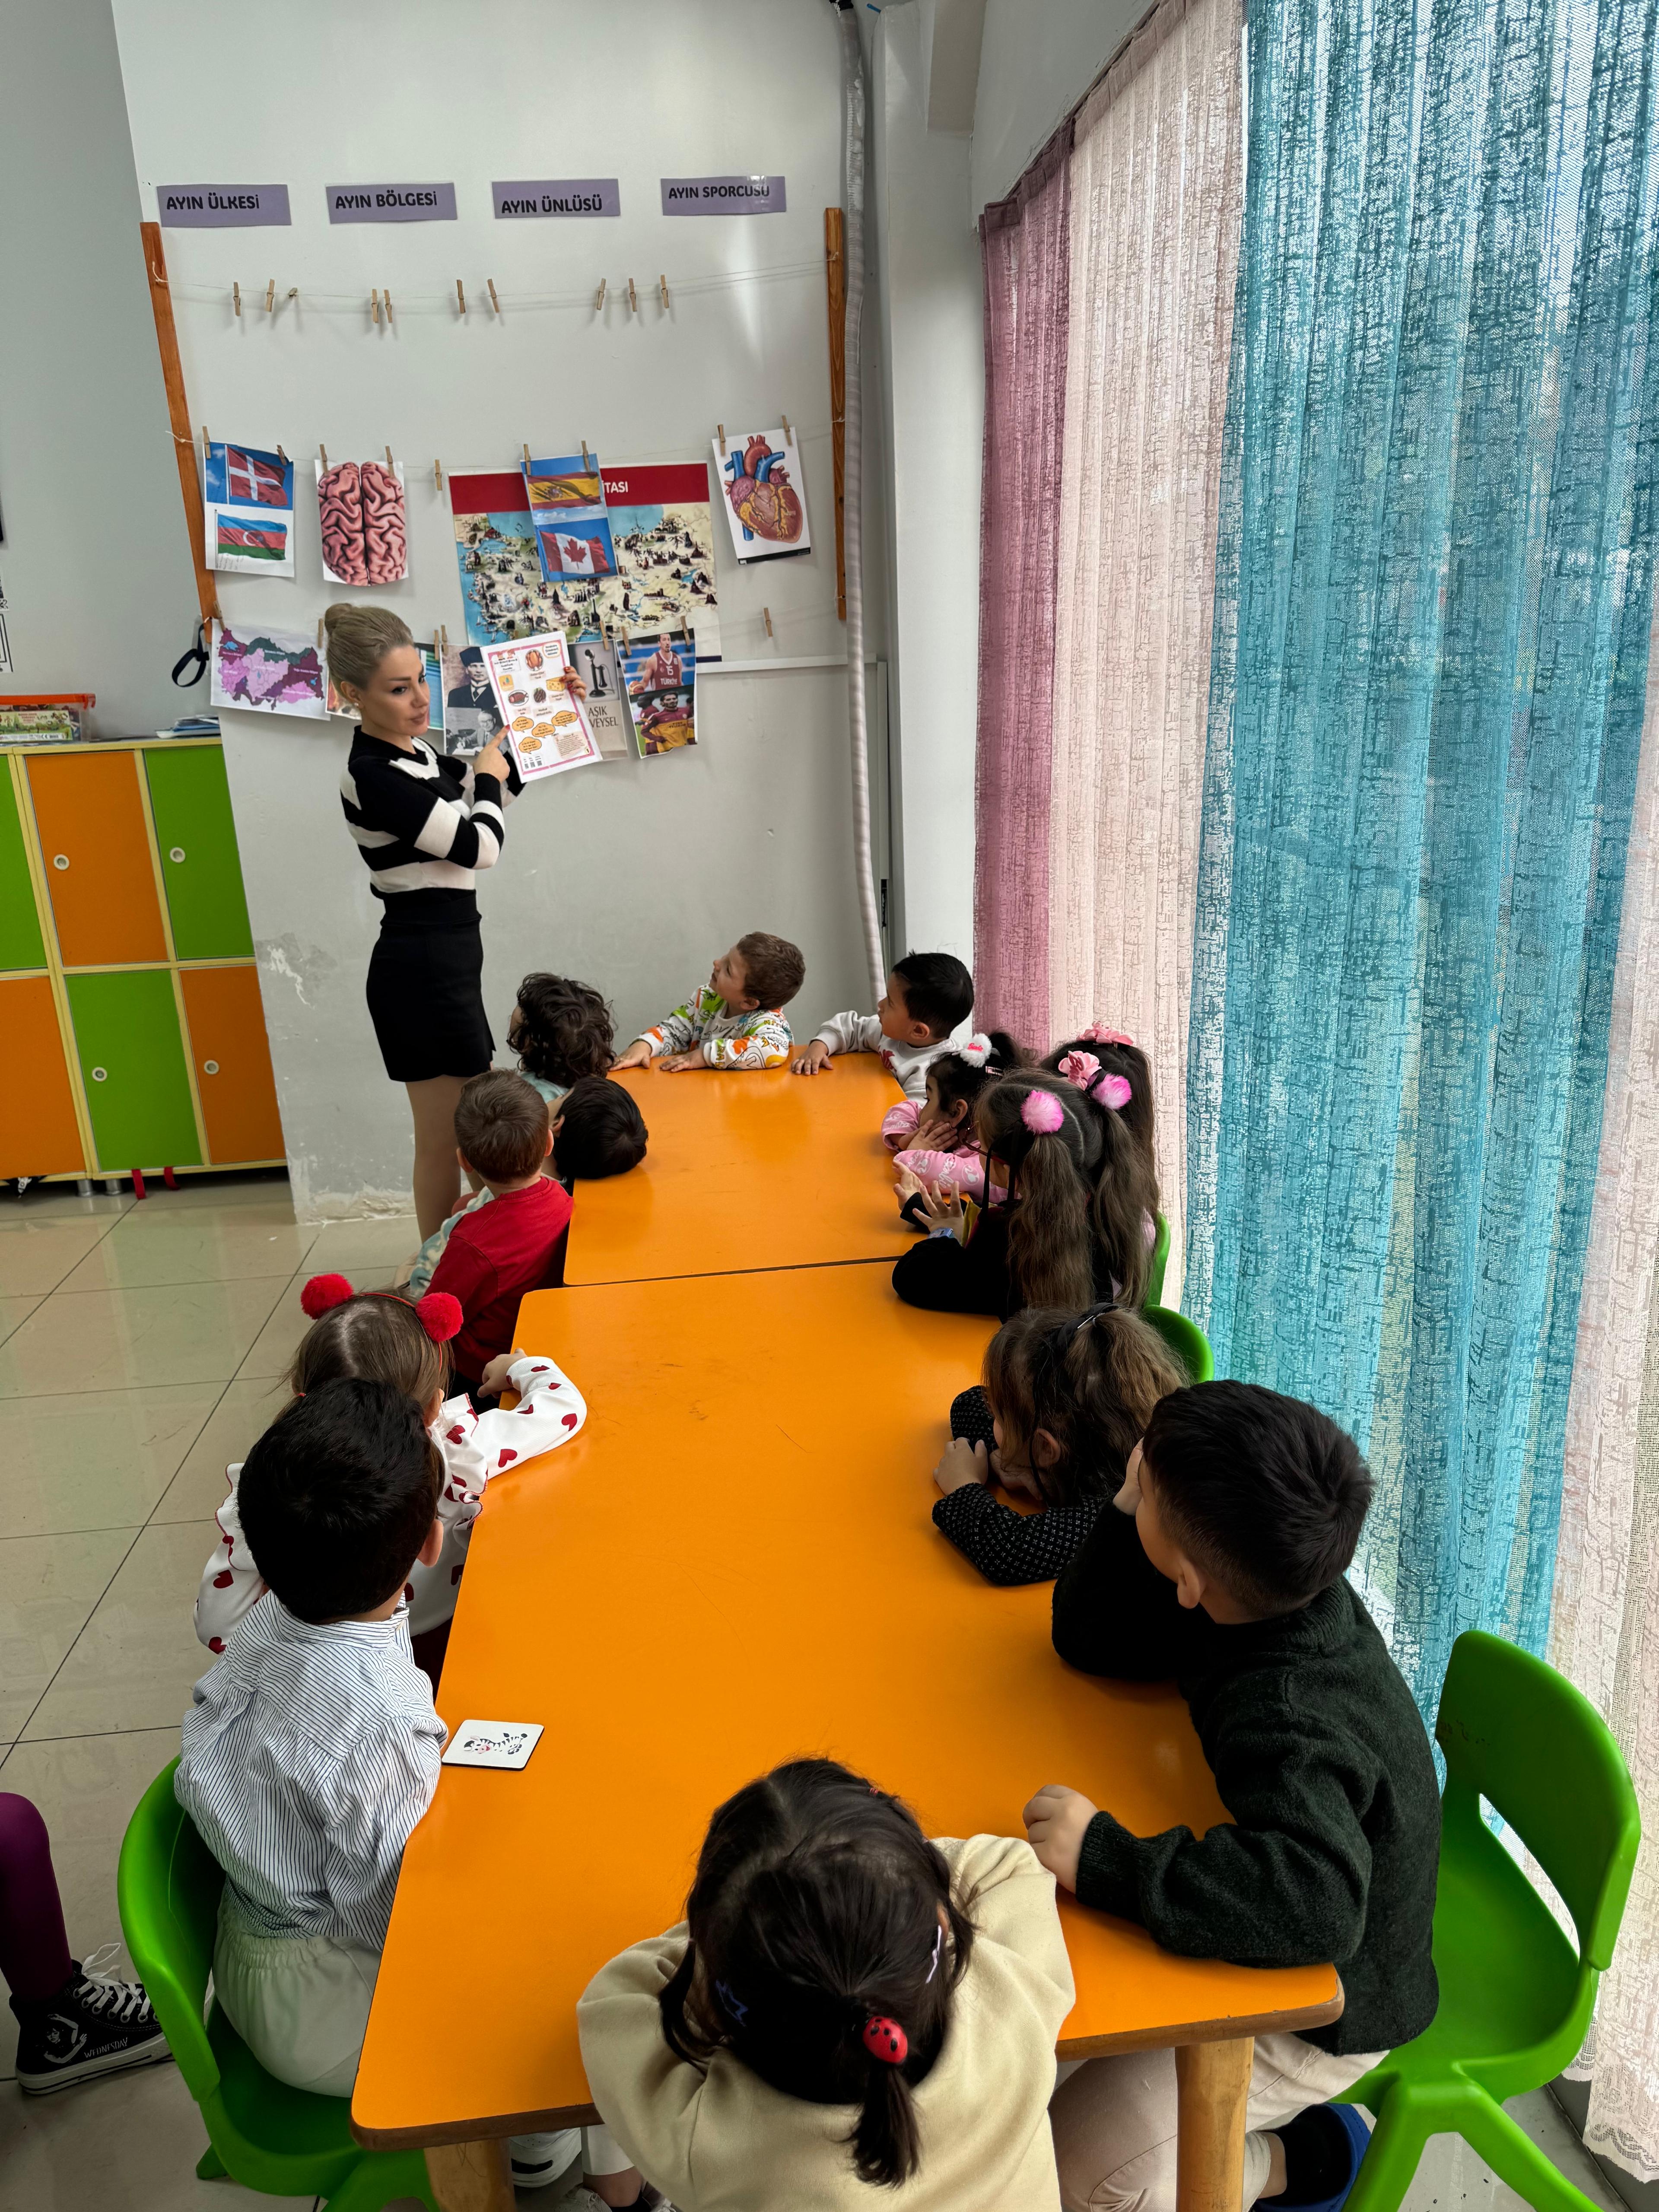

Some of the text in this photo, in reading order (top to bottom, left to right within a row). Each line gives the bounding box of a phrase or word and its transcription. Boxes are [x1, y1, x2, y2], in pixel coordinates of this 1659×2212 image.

[335, 189, 437, 209] AYIN BÖLGESİ
[668, 185, 769, 199] AYIN SPORCUSU
[166, 192, 260, 210] AYIN ÜLKESİ
[501, 194, 602, 213] AYIN ÜNLÜSÜ
[601, 480, 629, 494] İTASI
[666, 665, 674, 675] 15
[588, 706, 607, 718] AŞIK
[588, 716, 619, 728] VEYSEL
[84, 2037, 128, 2059] WEDNESDAY
